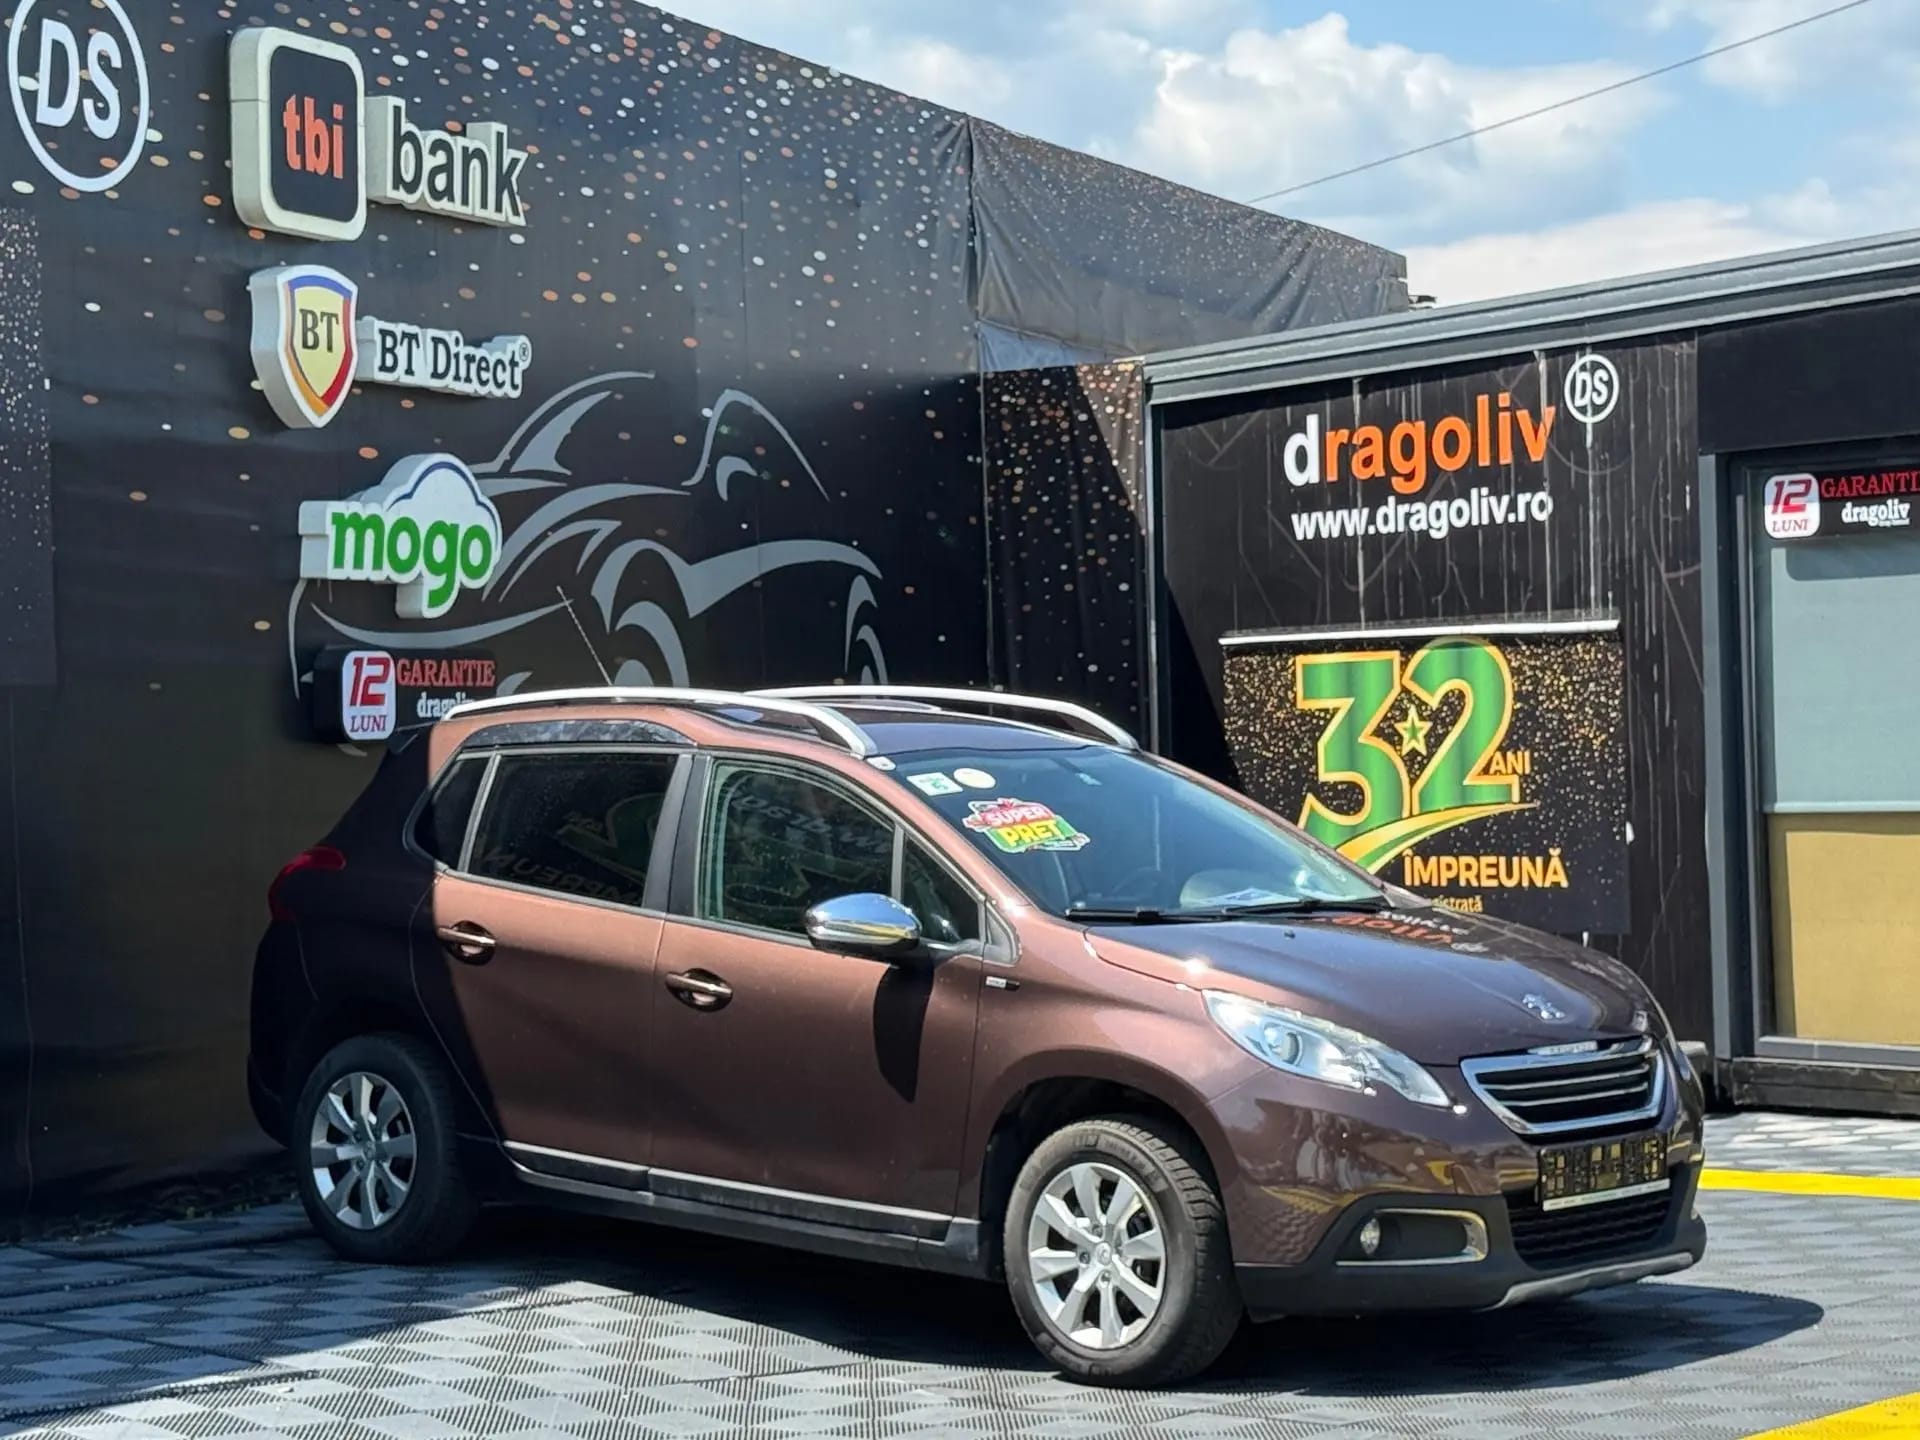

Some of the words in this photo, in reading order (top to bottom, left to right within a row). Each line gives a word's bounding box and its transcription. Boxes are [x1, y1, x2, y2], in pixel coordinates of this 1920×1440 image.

[36, 18, 122, 140] DS
[283, 93, 344, 179] tbi
[393, 105, 524, 218] bank
[299, 308, 339, 353] BT
[378, 329, 419, 377] BT
[1575, 366, 1608, 407] DS
[1283, 392, 1556, 494] dragoliv
[1291, 487, 1553, 540] www.dragoliv.ro
[1771, 478, 1812, 515] 12
[1841, 498, 1911, 527] dragoliv
[1771, 518, 1809, 533] LUNI
[331, 511, 493, 609] mogo
[350, 656, 391, 707] 12
[396, 658, 495, 688] GARANTIE
[350, 714, 388, 733] LUNI
[1295, 638, 1520, 850] 32
[1488, 751, 1531, 776] ANI
[985, 806, 1051, 826] SUPER
[1403, 848, 1569, 888] ÎMPREUNĂ
